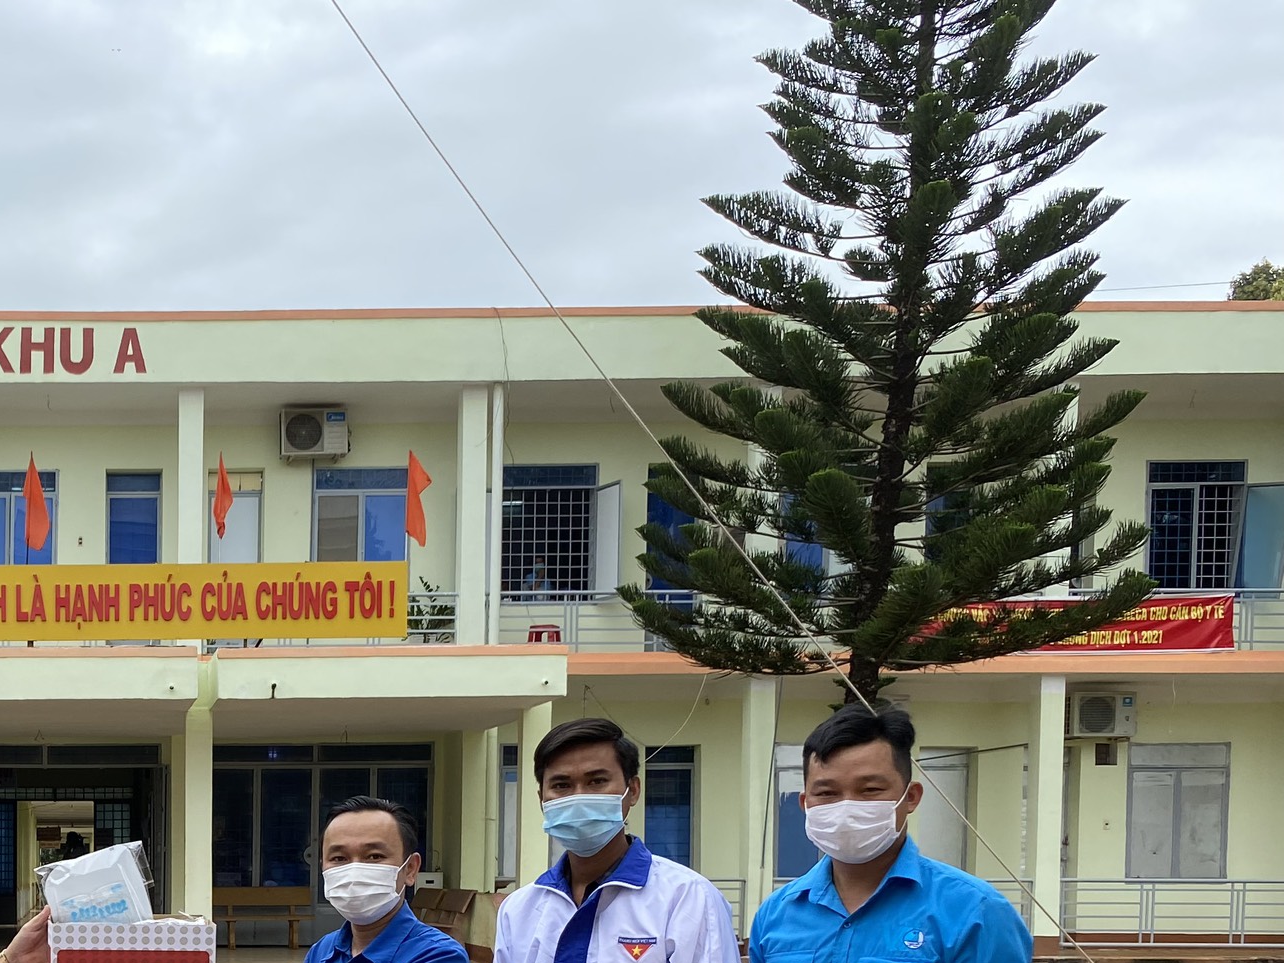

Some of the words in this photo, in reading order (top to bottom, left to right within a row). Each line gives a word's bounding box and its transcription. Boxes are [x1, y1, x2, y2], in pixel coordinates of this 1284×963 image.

[114, 327, 147, 374] A
[16, 575, 46, 622] LÀ
[55, 584, 119, 630] HẠNH
[129, 574, 192, 621] PHÚC
[201, 570, 248, 621] CỦA
[256, 572, 338, 621] CHÚNG
[345, 572, 383, 620] TÔI
[1150, 606, 1167, 620] CHO
[1170, 603, 1189, 620] CÁN
[1191, 603, 1203, 622] BỘ
[1213, 602, 1226, 619] TẾ
[1090, 630, 1112, 648] DỊCH
[1133, 630, 1163, 644] 1.2021
